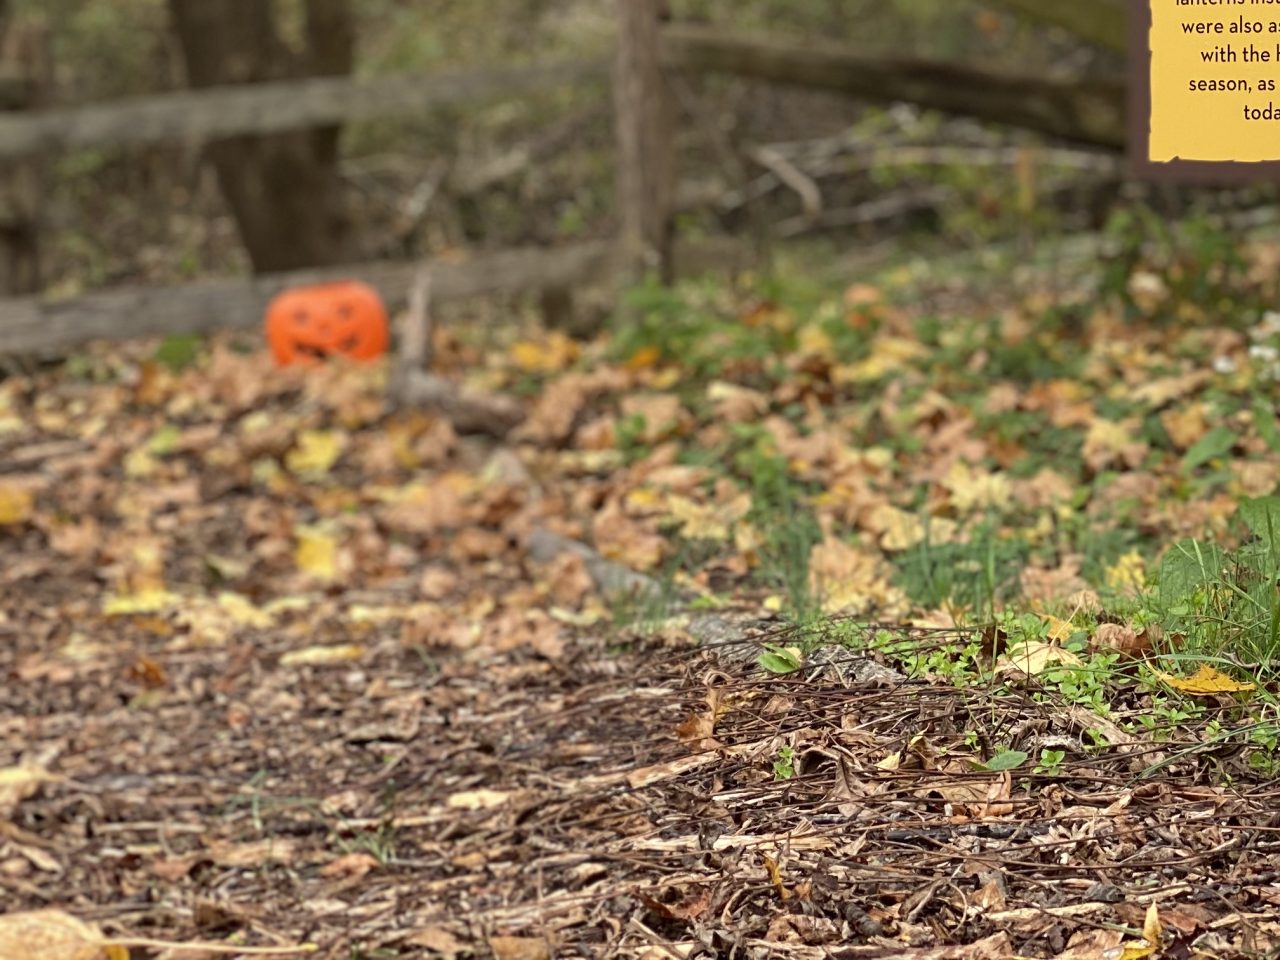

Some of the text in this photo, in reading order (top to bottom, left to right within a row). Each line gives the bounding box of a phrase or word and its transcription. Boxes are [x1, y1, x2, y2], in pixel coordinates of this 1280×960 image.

[1181, 22, 1224, 35] were
[1228, 14, 1264, 34] also
[1200, 43, 1237, 63] with
[1242, 43, 1271, 63] the
[1189, 79, 1252, 94] season,
[1257, 79, 1276, 92] as
